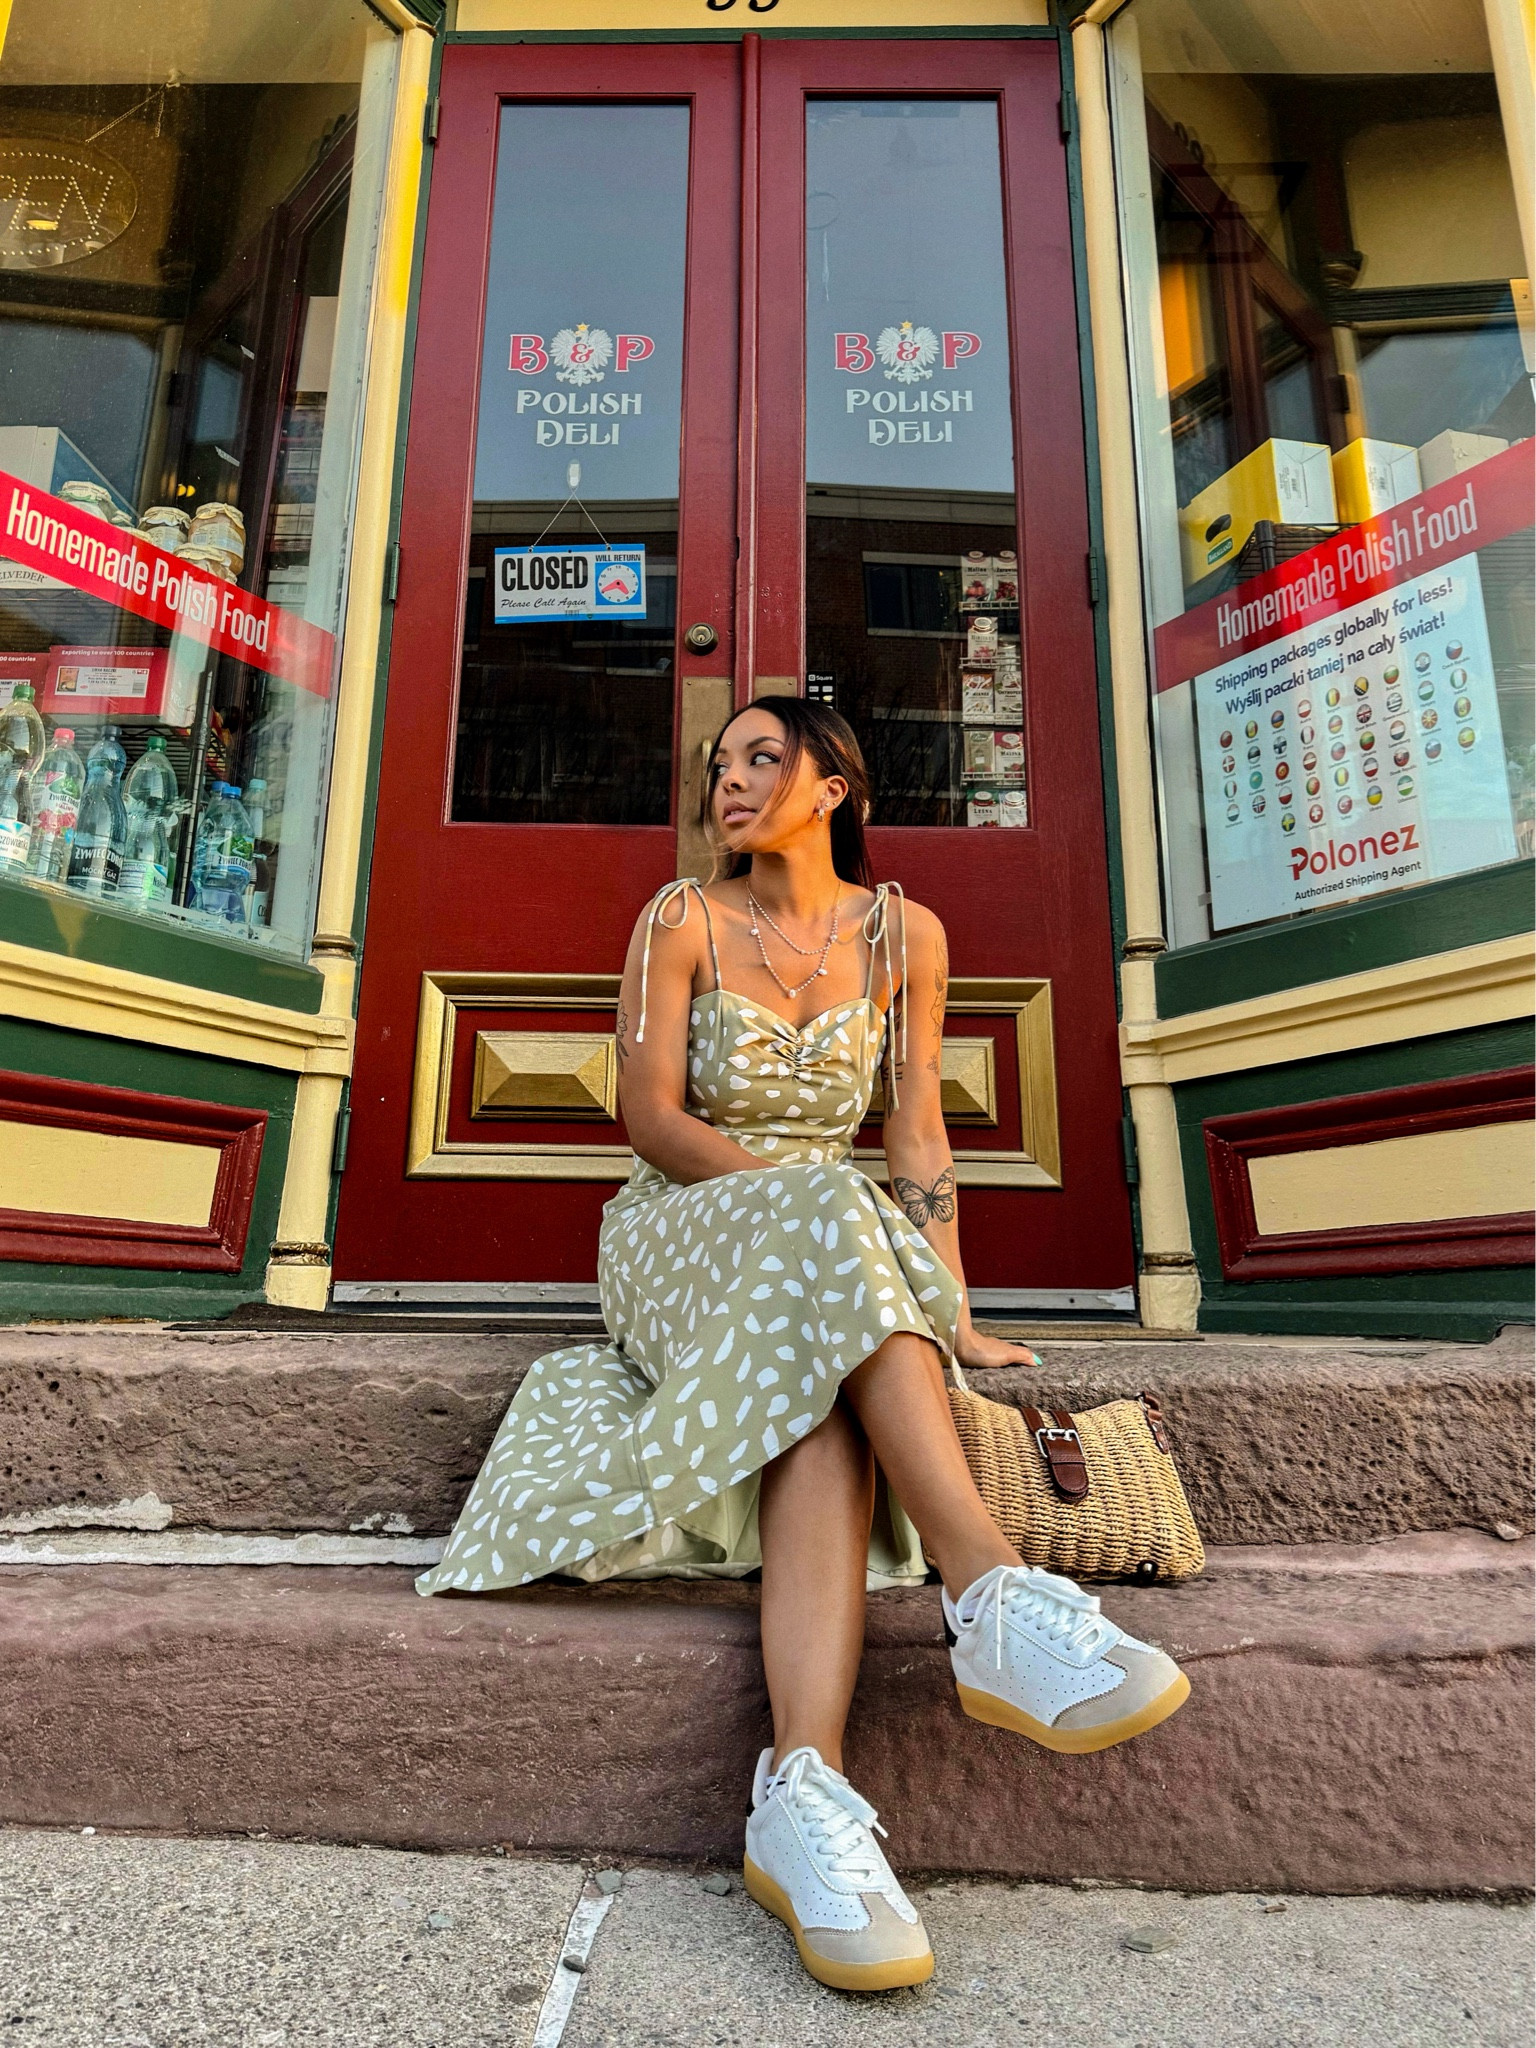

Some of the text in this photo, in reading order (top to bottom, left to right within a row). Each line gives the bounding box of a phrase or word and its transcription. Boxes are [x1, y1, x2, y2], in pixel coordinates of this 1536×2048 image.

[508, 334, 656, 375] B & P
[834, 331, 982, 374] B & P
[516, 389, 642, 415] POLISH
[846, 388, 974, 414] POLISH
[536, 419, 620, 447] DELI
[868, 418, 953, 446] DELI
[6, 487, 271, 652] Homemade Polish Food
[501, 556, 589, 592] CLOSED
[595, 554, 641, 562] WILL RETURN
[1216, 482, 1479, 648] Homemade Polish Food
[501, 597, 587, 609] Please Call Again
[61, 649, 91, 657] Exporting
[1215, 577, 1454, 694] Shipping packages globally for less!
[1225, 611, 1446, 715] Wyślij paczki taniej na cały świat!
[75, 846, 107, 860] ŻYWIEC
[1289, 824, 1420, 881] Polonez
[1294, 861, 1422, 900] Authorized Shipping Agent
